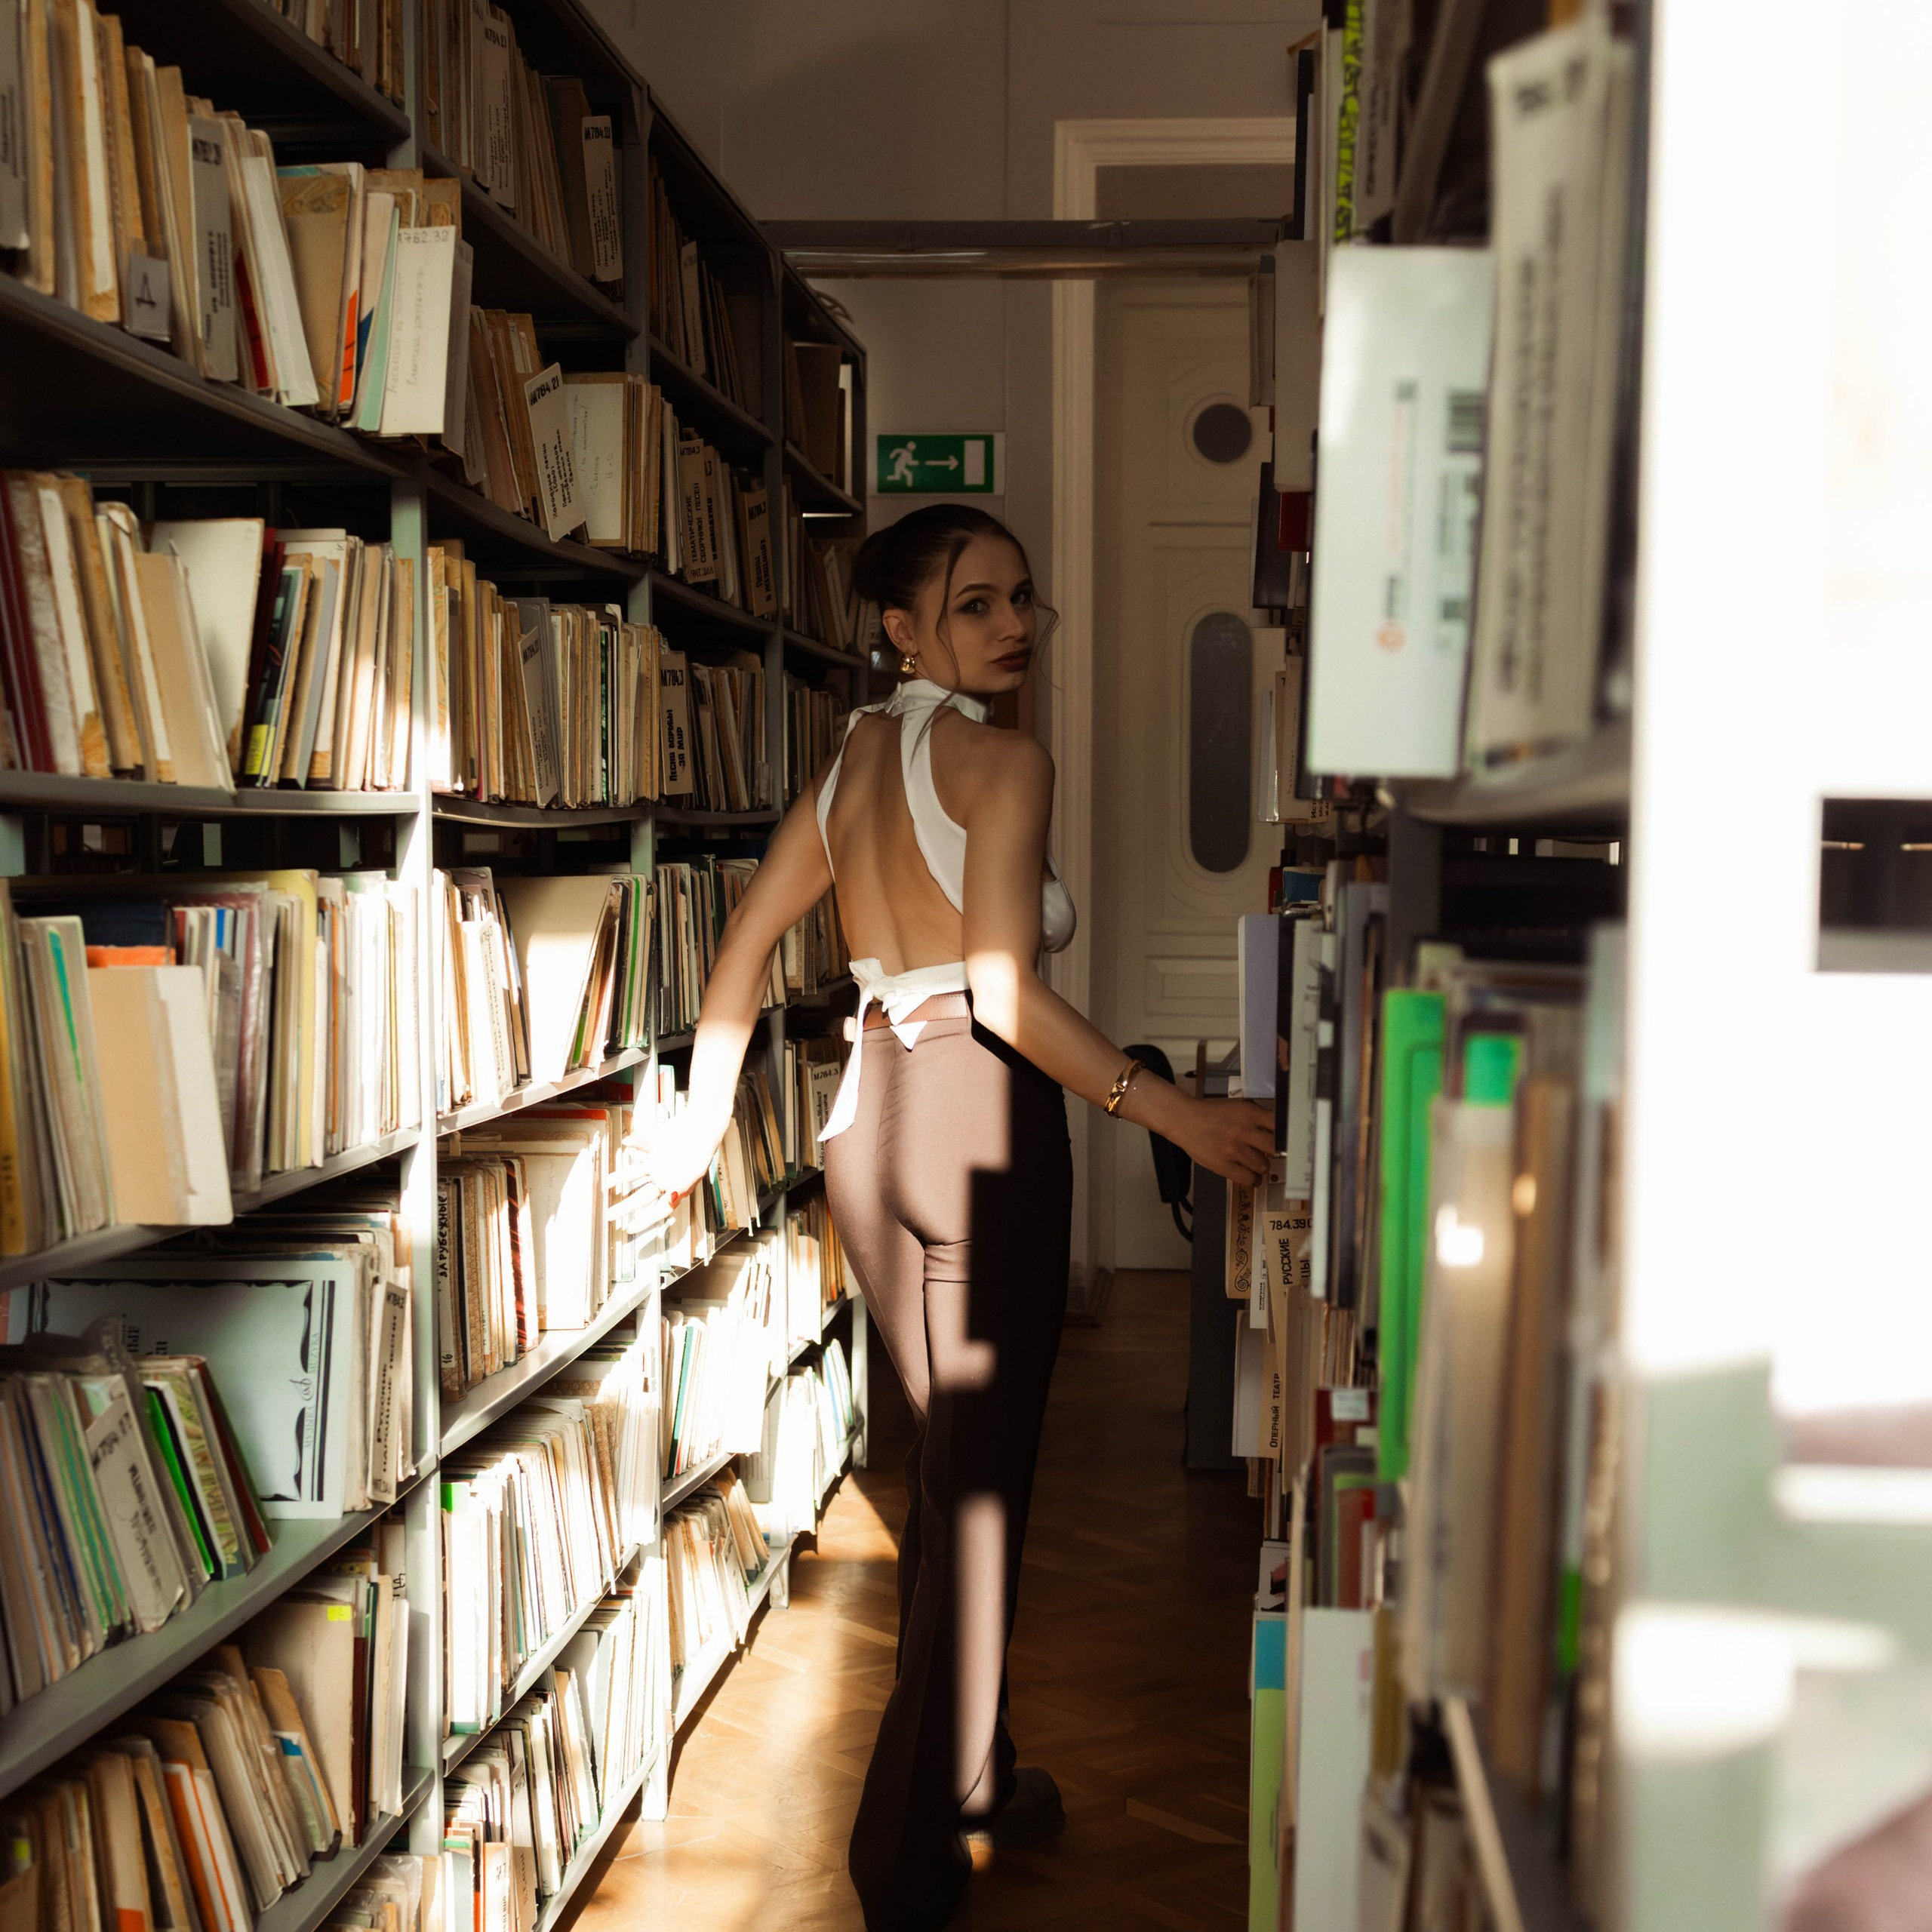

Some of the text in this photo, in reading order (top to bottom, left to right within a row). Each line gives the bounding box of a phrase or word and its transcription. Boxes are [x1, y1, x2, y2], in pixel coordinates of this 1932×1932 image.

[685, 495, 698, 564] ТЕМАТИЧЕСКИЕ
[696, 516, 706, 564] СБОРНИКИ
[1278, 1238, 1294, 1284] РУССКИЕ
